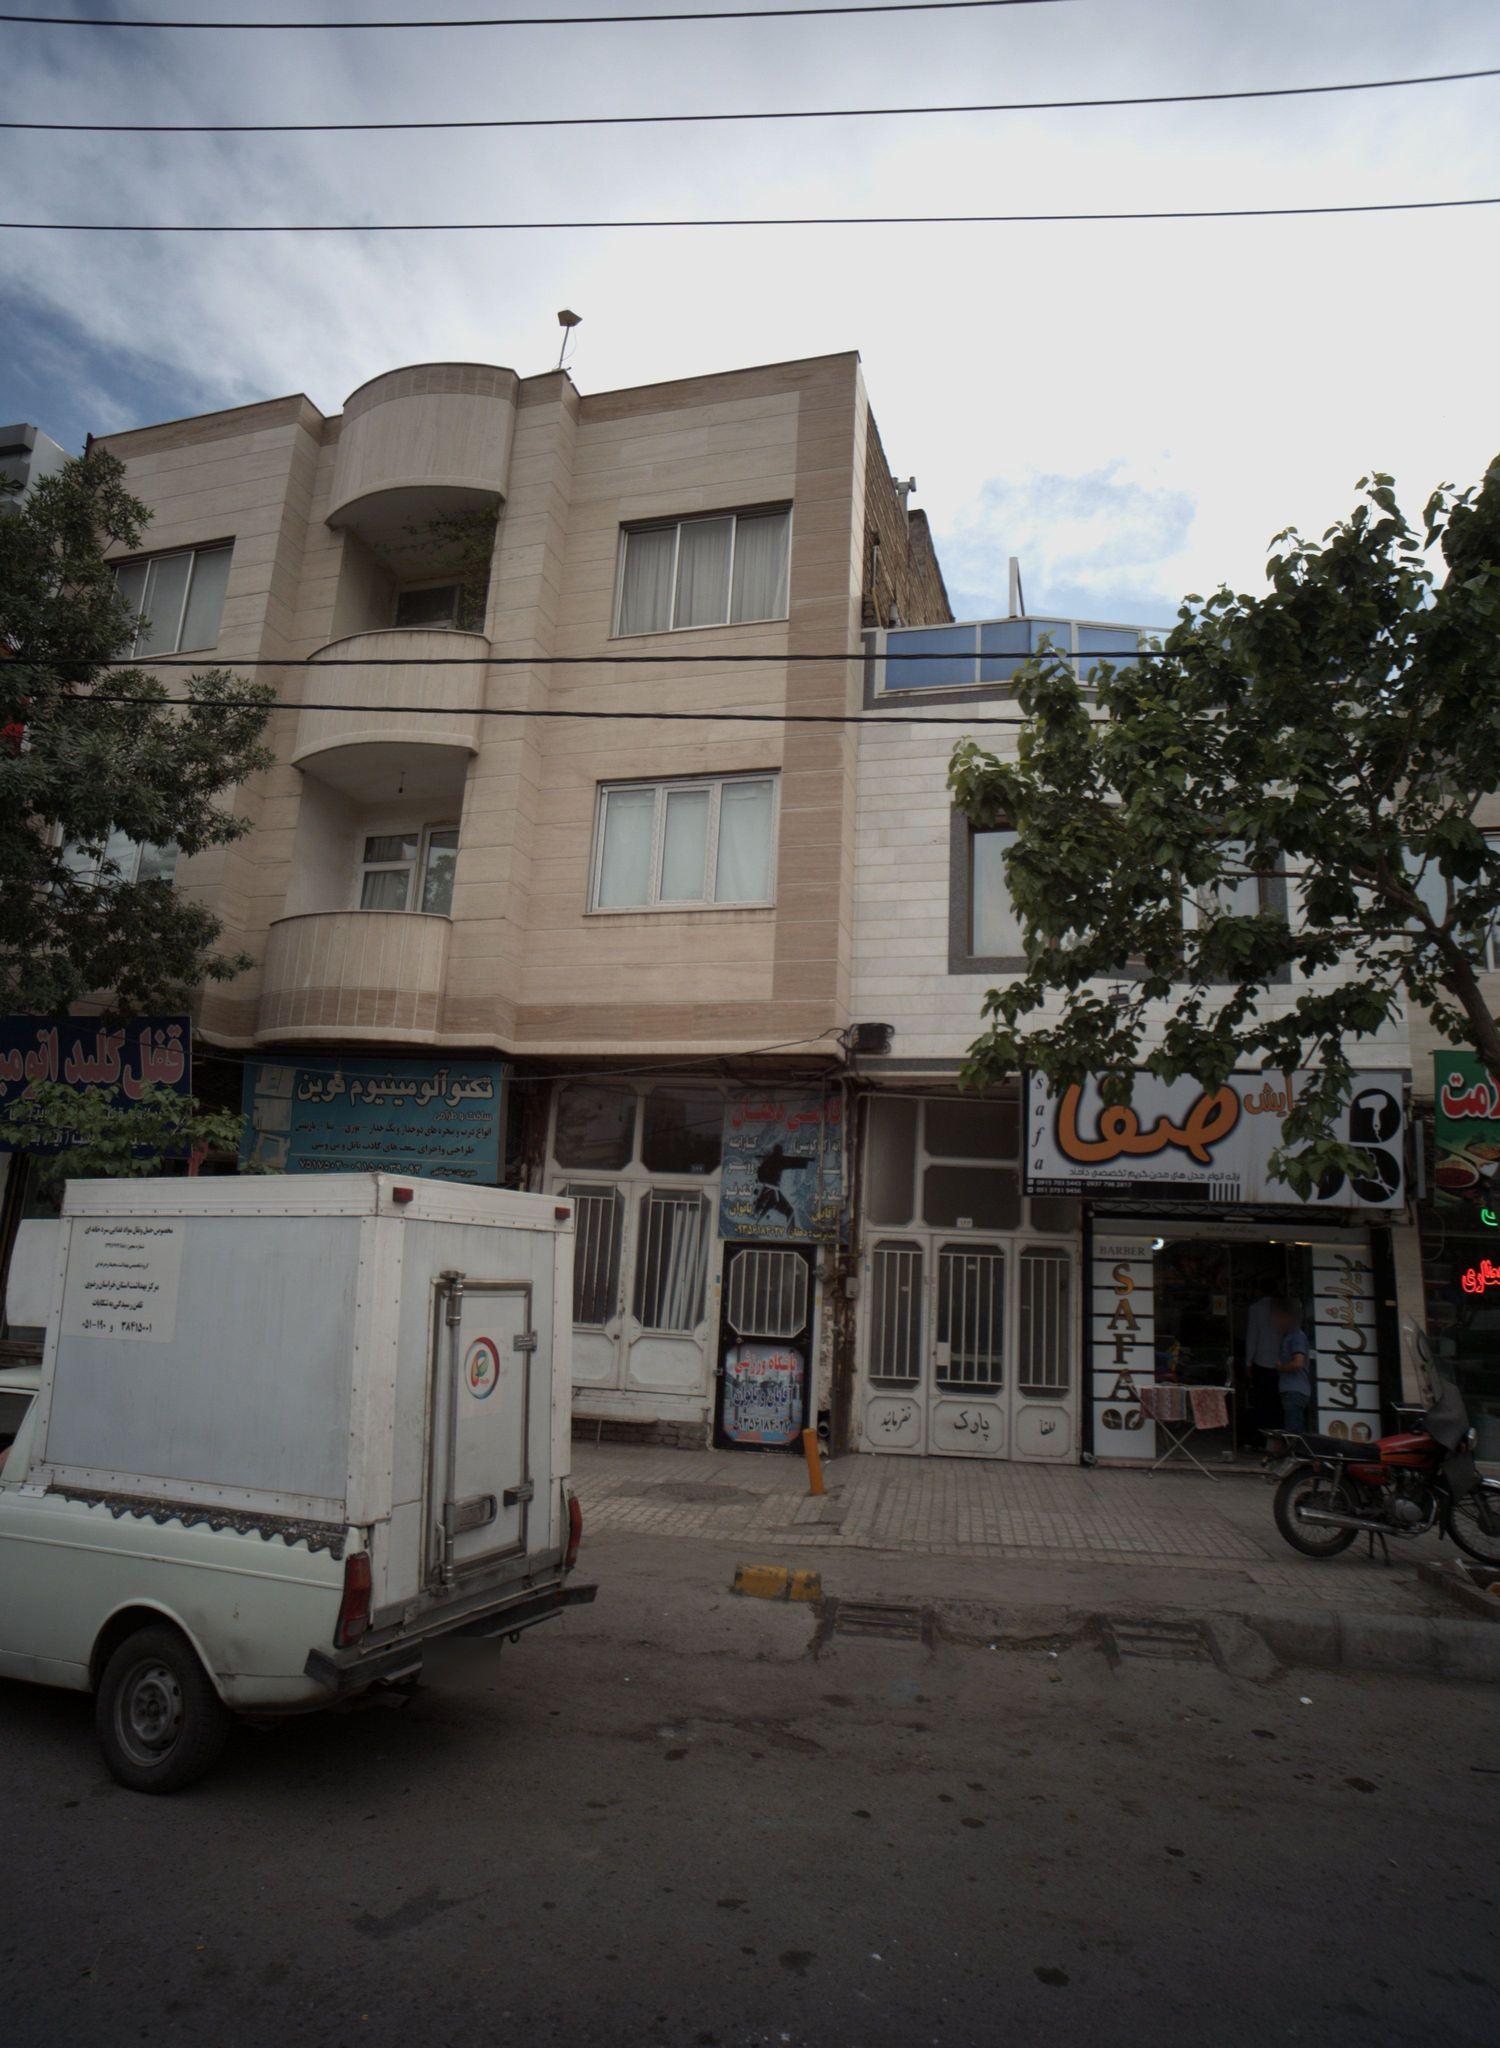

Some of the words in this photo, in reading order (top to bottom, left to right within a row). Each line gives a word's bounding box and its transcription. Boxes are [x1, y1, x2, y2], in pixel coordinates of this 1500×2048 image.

[64, 1026, 126, 1095] کلید
[122, 1024, 185, 1100] قفل
[1057, 1075, 1240, 1163] صفا
[446, 1144, 475, 1157] طراحی
[1091, 1168, 1127, 1178] تخصصی
[1099, 1245, 1146, 1257] BARBER
[129, 1281, 147, 1291] بهداشت
[146, 1282, 159, 1293] مرکز
[1106, 1262, 1141, 1401] SAFA
[733, 1350, 767, 1376] ورزشی
[768, 1352, 797, 1371] باشگاه
[1329, 1350, 1359, 1409] صفا
[953, 1411, 990, 1441] پارک
